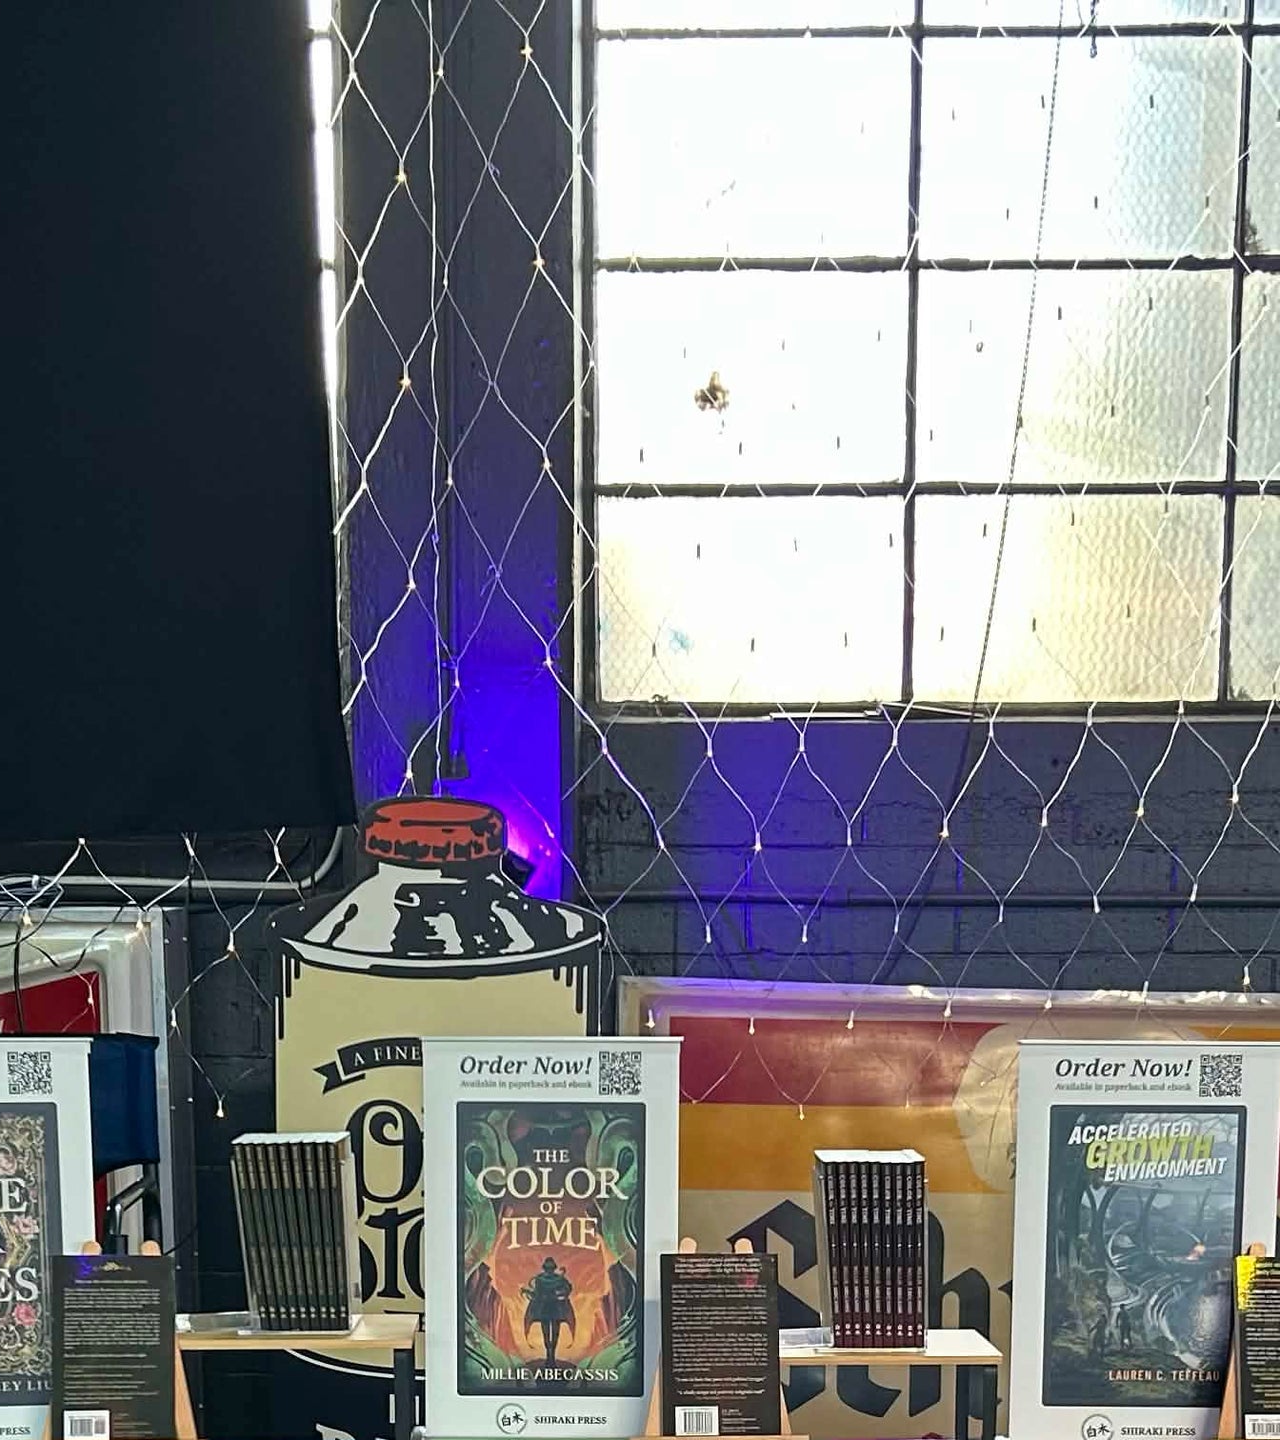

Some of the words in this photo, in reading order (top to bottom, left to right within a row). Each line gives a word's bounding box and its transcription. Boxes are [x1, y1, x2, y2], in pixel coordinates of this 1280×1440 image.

[353, 1052, 365, 1065] A
[372, 1046, 421, 1062] FINE
[460, 1055, 528, 1075] Order
[533, 1056, 593, 1075] Now!
[1055, 1058, 1126, 1077] Order
[1129, 1058, 1194, 1077] Now!
[1067, 1121, 1192, 1145] ACCELERATED
[533, 1149, 570, 1163] THE
[1085, 1135, 1216, 1169] GROWTH
[1104, 1157, 1227, 1182] ENVIRONMENT
[475, 1166, 629, 1200] COLOR
[539, 1201, 563, 1214] OF
[501, 1217, 601, 1251] TIME
[481, 1367, 530, 1380] MILLIE
[533, 1367, 620, 1381] ABECASSIS
[1108, 1369, 1152, 1381] LAUREN
[1156, 1369, 1167, 1381] C.
[1171, 1368, 1221, 1381] TEFFEAU
[500, 1411, 524, 1427] 白木
[534, 1415, 575, 1425] SHIRAKI
[577, 1416, 608, 1425] PRESS
[0, 1426, 31, 1436] PRESS
[1085, 1422, 1111, 1438] 白木
[1120, 1426, 1163, 1436] SHIRAKI
[1165, 1427, 1196, 1436] PRESS
